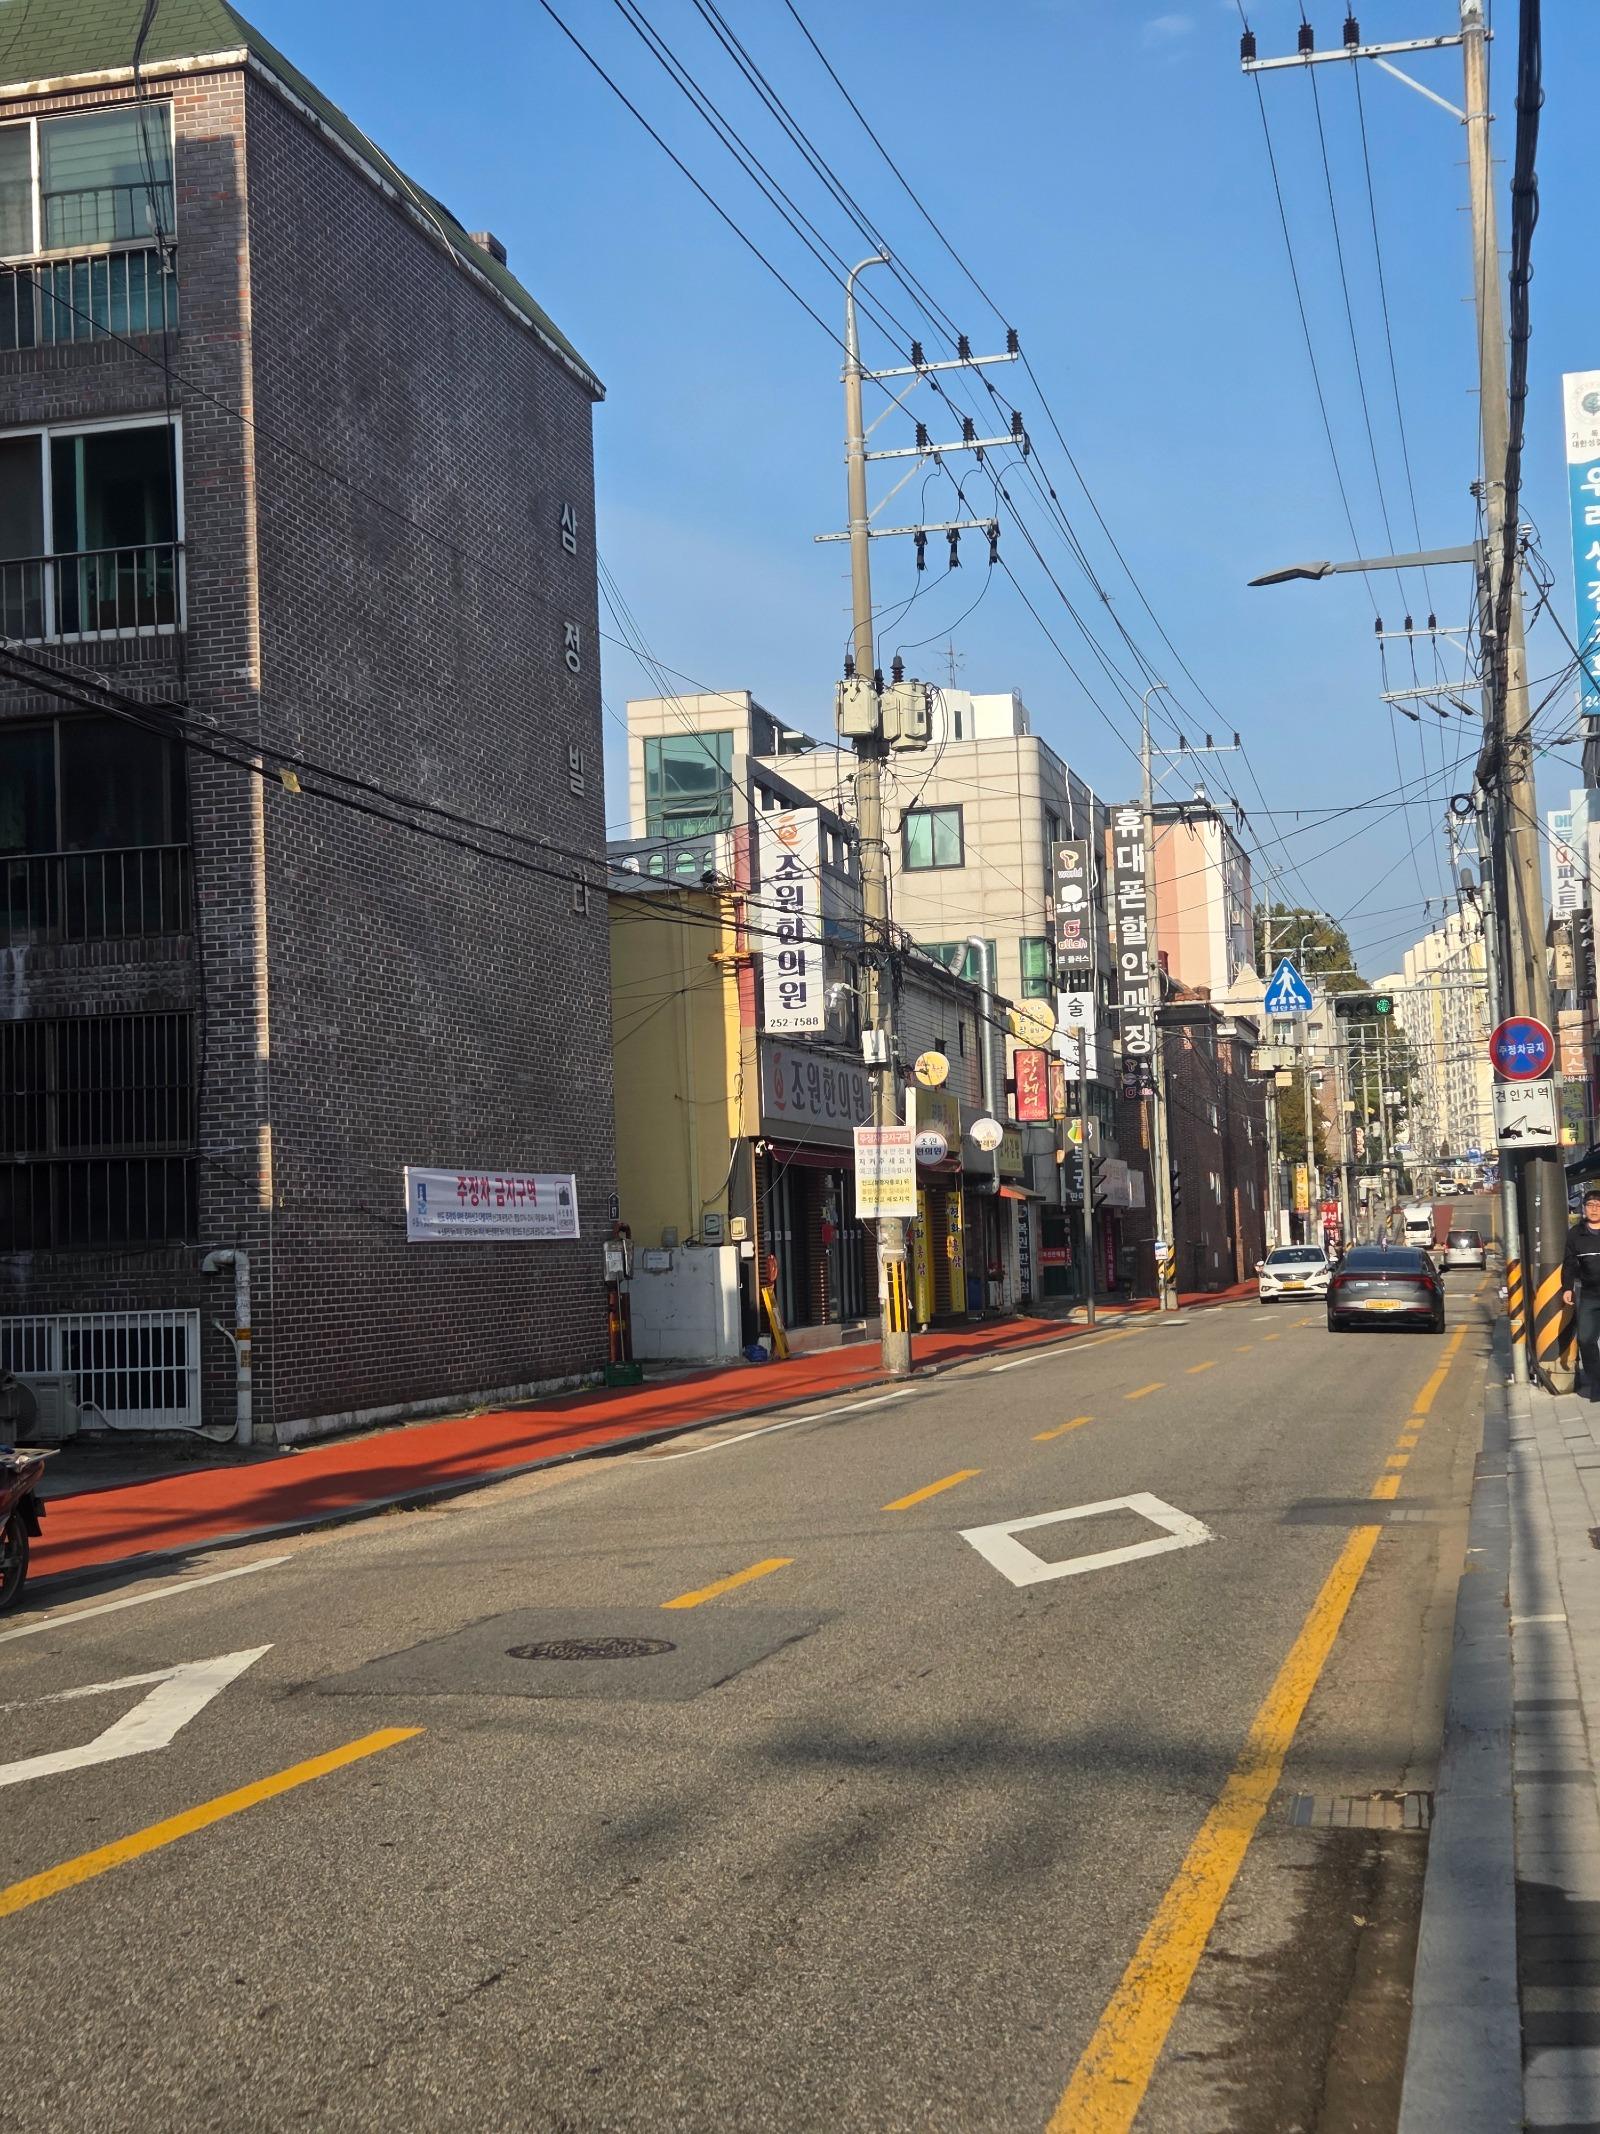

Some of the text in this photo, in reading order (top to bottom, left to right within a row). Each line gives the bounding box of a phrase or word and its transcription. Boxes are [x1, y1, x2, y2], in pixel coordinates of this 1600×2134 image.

[559, 502, 591, 917] 삼정빌라
[1057, 867, 1083, 879] world
[774, 853, 808, 1010] 조원한의원
[1058, 937, 1088, 950] olleh
[1067, 997, 1085, 1018] 술
[769, 1016, 820, 1028] 252-7588
[1499, 1042, 1546, 1056] 주정차금지
[790, 1060, 866, 1123] 조원한의원
[1494, 1086, 1549, 1104] 견인지역
[920, 1137, 937, 1146] 조원
[457, 1175, 491, 1207] 주정차
[494, 1177, 537, 1207] 금지구역
